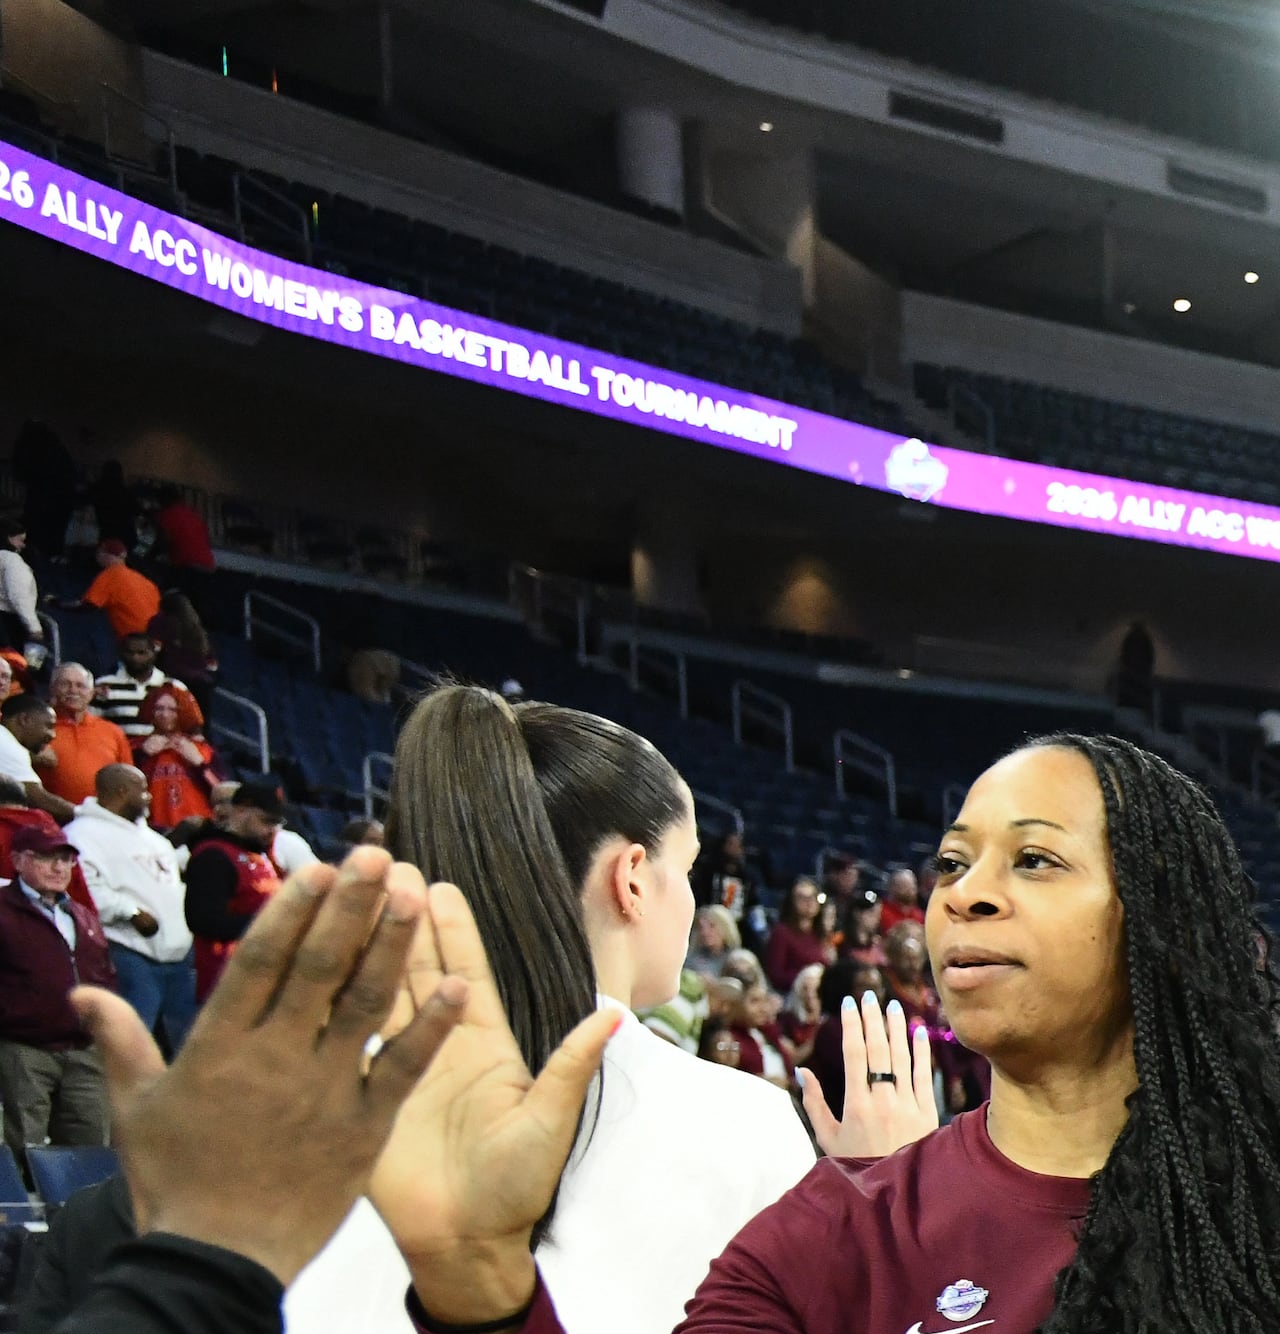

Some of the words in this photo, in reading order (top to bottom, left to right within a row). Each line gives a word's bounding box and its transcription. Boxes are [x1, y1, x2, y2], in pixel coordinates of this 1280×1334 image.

[40, 183, 124, 245] ALLY
[129, 220, 198, 276] ACC
[202, 248, 364, 332] WOMEN'S
[370, 303, 590, 396] BASKETBALL
[591, 366, 798, 451] TOURNAMENT
[1118, 495, 1186, 532] ALLY
